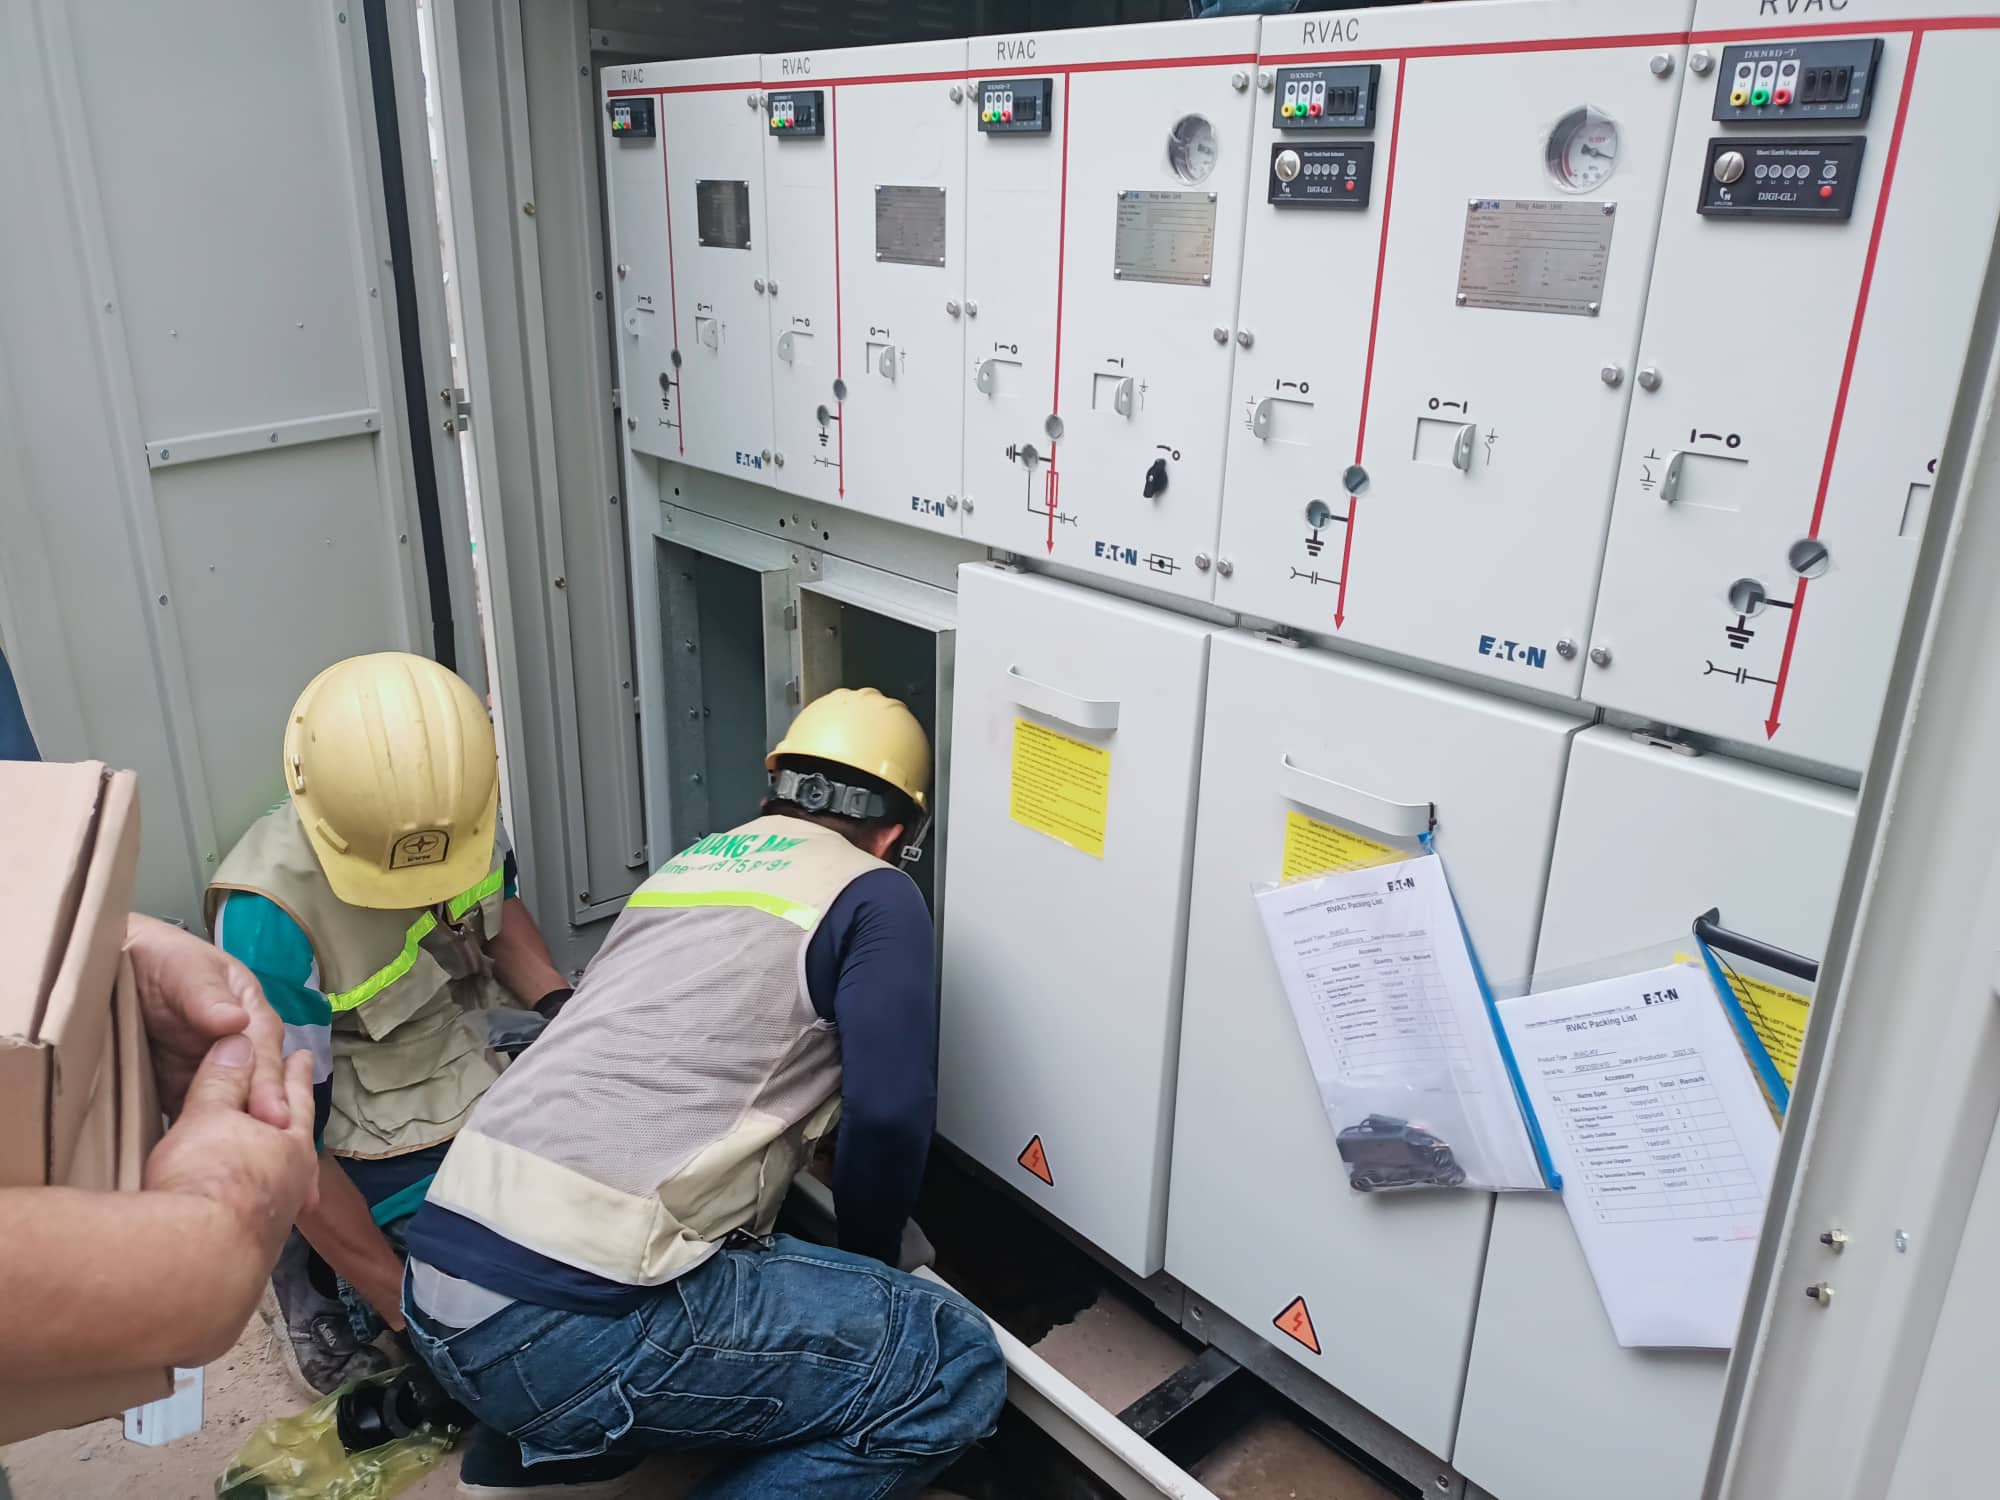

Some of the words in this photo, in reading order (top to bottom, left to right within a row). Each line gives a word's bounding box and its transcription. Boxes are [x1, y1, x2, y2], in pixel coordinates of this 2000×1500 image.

[1302, 18, 1360, 44] RVAC
[997, 40, 1036, 60] RVAC
[782, 57, 811, 75] RVAC
[620, 69, 644, 84] RVAC
[1326, 903, 1347, 914] RVAC
[1566, 1022, 1588, 1032] RVAC
[1590, 1016, 1621, 1028] Packing
[1622, 1014, 1638, 1023] List
[1624, 1084, 1649, 1094] Quantity
[1659, 1080, 1675, 1088] Total
[1680, 1076, 1705, 1085] Remark
